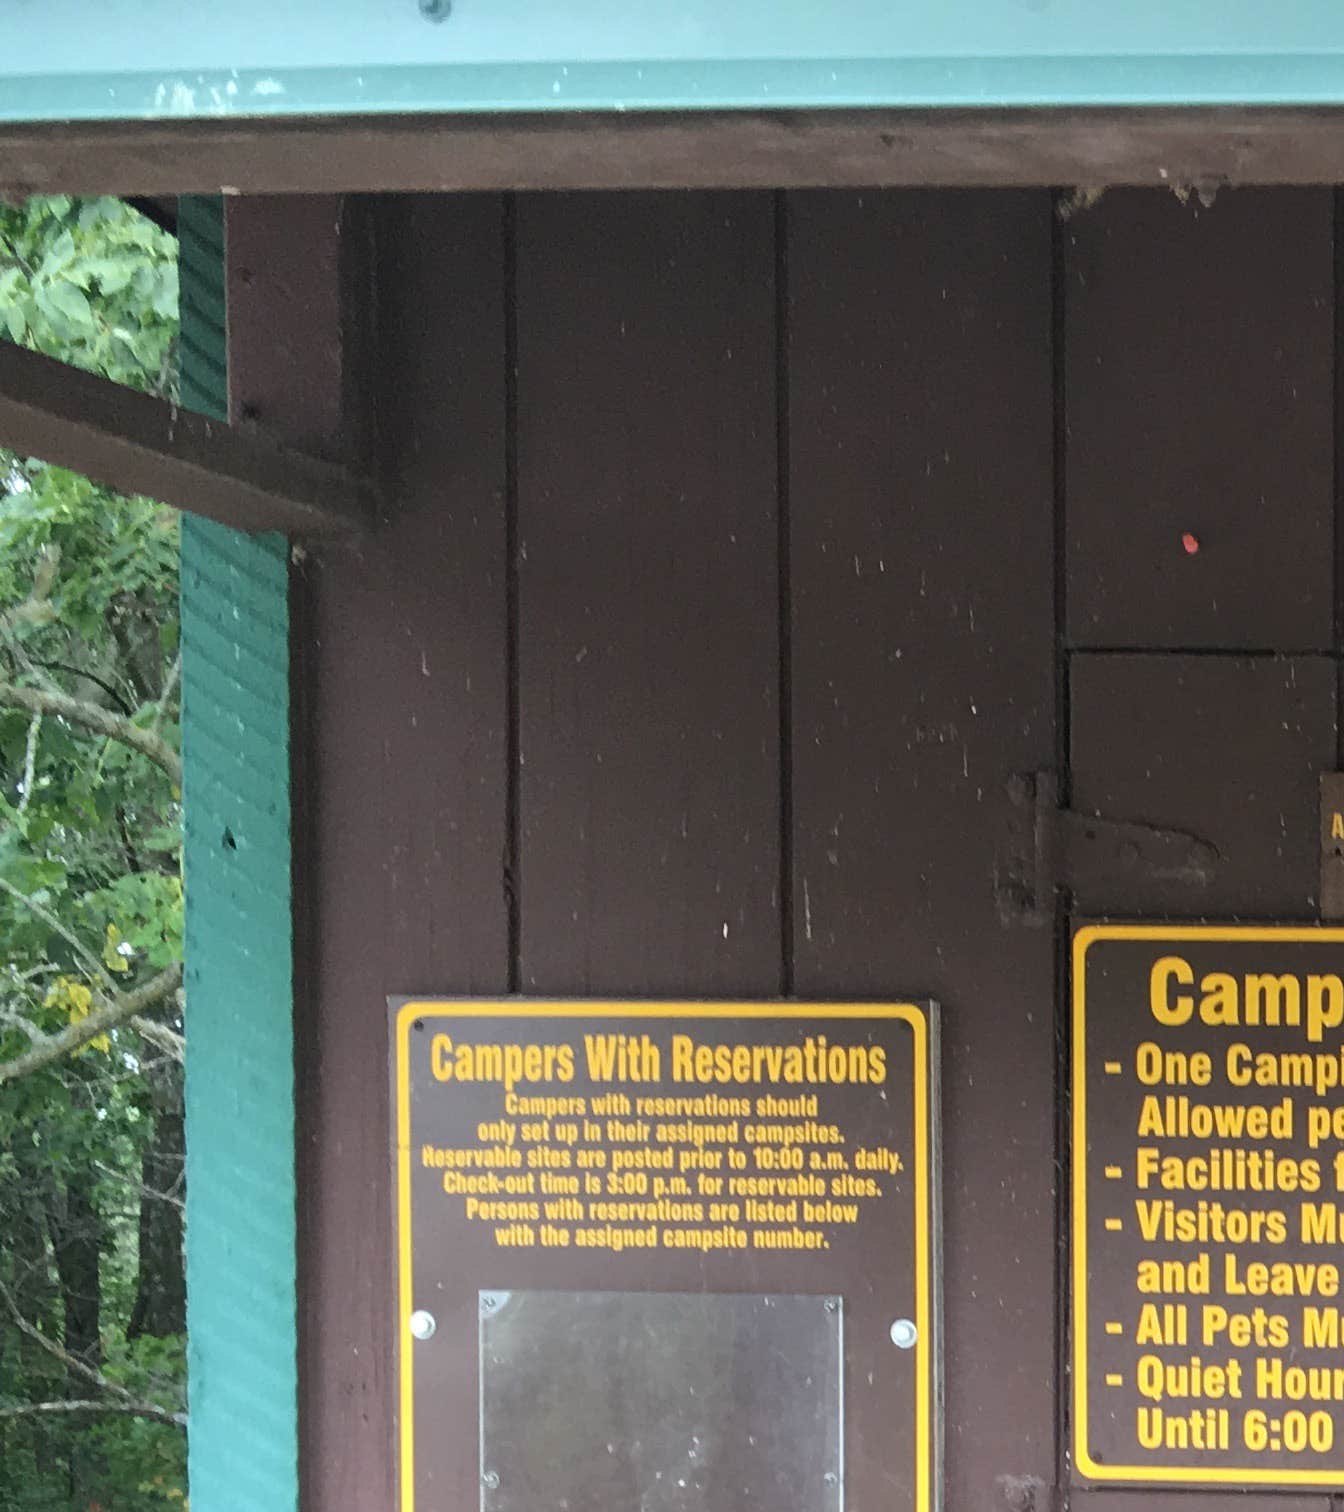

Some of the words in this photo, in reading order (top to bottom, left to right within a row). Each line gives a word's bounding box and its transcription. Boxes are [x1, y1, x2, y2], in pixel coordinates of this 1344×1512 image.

[1331, 812, 1344, 840] A
[430, 1032, 575, 1089] Campers
[584, 1034, 660, 1082] With
[672, 1035, 886, 1084] Reservations
[1136, 1042, 1212, 1086] One
[505, 1092, 586, 1118] Campers
[590, 1092, 631, 1116] with
[636, 1094, 751, 1117] reservations
[756, 1094, 818, 1117] should
[1138, 1095, 1293, 1139] Allowed
[477, 1119, 517, 1150] only
[521, 1119, 550, 1142] set
[554, 1123, 579, 1147] up
[583, 1119, 601, 1142] in
[606, 1119, 651, 1142] their
[655, 1120, 738, 1144] assigned
[526, 1145, 572, 1169] sites
[576, 1149, 607, 1169] are
[612, 1146, 674, 1170] posted
[679, 1145, 723, 1173] prior
[727, 1147, 747, 1169] to
[753, 1146, 804, 1170] 10:00
[1137, 1147, 1321, 1192] Facilities
[443, 1170, 535, 1195] Check-out
[539, 1171, 580, 1195] time
[585, 1171, 601, 1195] is
[606, 1171, 648, 1195] 3:00
[697, 1173, 723, 1195] for
[729, 1174, 826, 1197] reservable
[466, 1198, 540, 1221] Persons
[543, 1199, 584, 1221] with
[589, 1199, 704, 1222] reservations
[708, 1203, 740, 1222] are
[745, 1200, 797, 1223] listed
[803, 1200, 858, 1223] below
[1136, 1199, 1287, 1244] Visitors
[494, 1224, 535, 1247] with
[539, 1224, 570, 1247] the
[574, 1224, 658, 1251] assigned
[663, 1225, 748, 1252] campsite
[1137, 1253, 1210, 1295] and
[1225, 1253, 1339, 1297] Leave
[1136, 1303, 1187, 1346] All
[1202, 1304, 1289, 1348] Pets
[1137, 1357, 1242, 1402] Quiet
[1137, 1407, 1229, 1450] Until
[1243, 1409, 1333, 1453] 6:00
